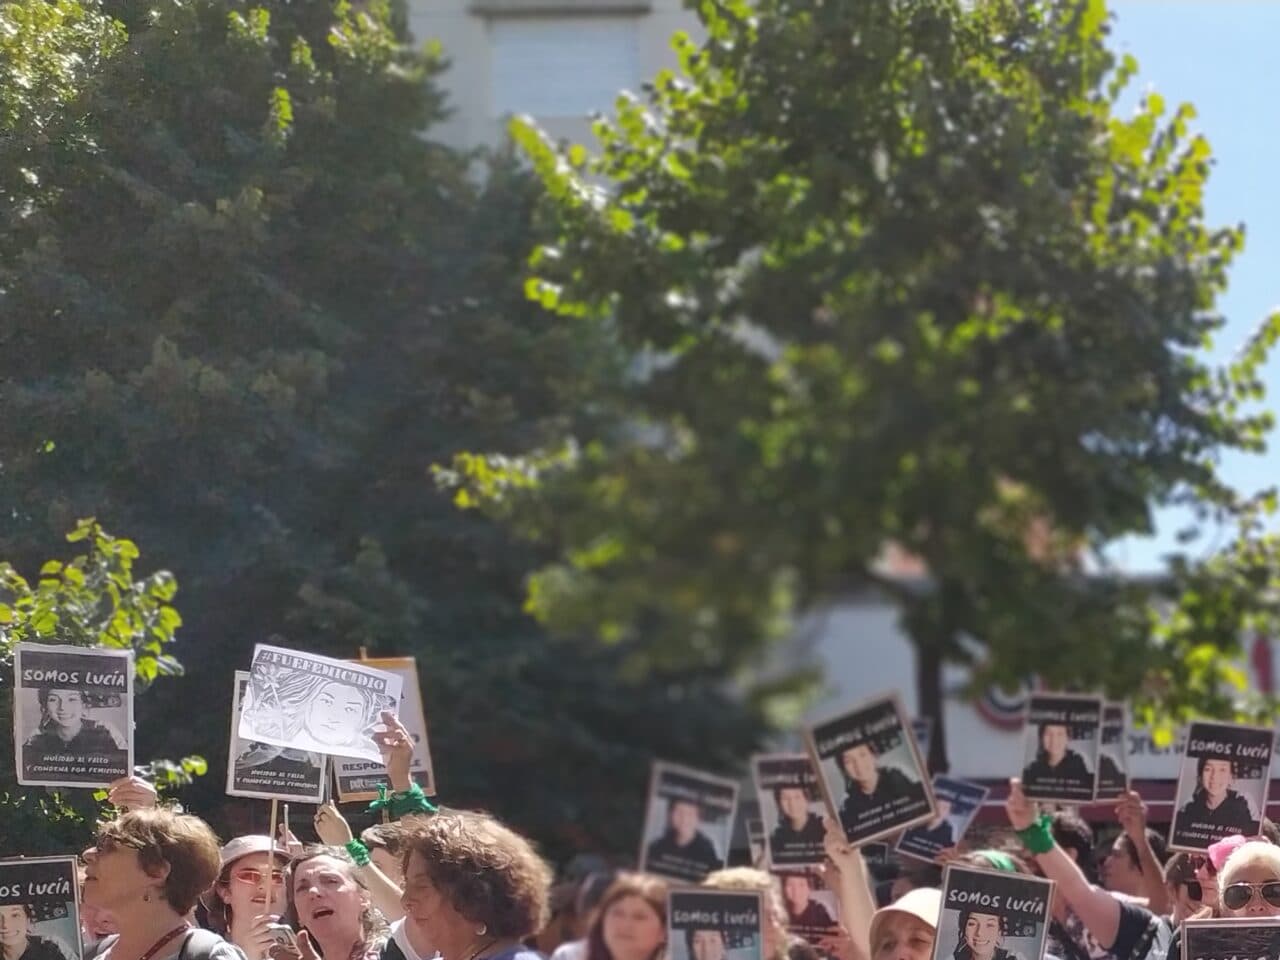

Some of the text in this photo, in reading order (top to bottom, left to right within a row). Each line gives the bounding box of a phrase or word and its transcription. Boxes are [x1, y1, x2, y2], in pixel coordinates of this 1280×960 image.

[24, 669, 125, 687] SOMOS LUCÍA
[1190, 740, 1269, 758] SOMOS LUCÍA
[29, 877, 70, 896] LUCÍA
[948, 889, 1044, 915] SOMOS LUCÍA
